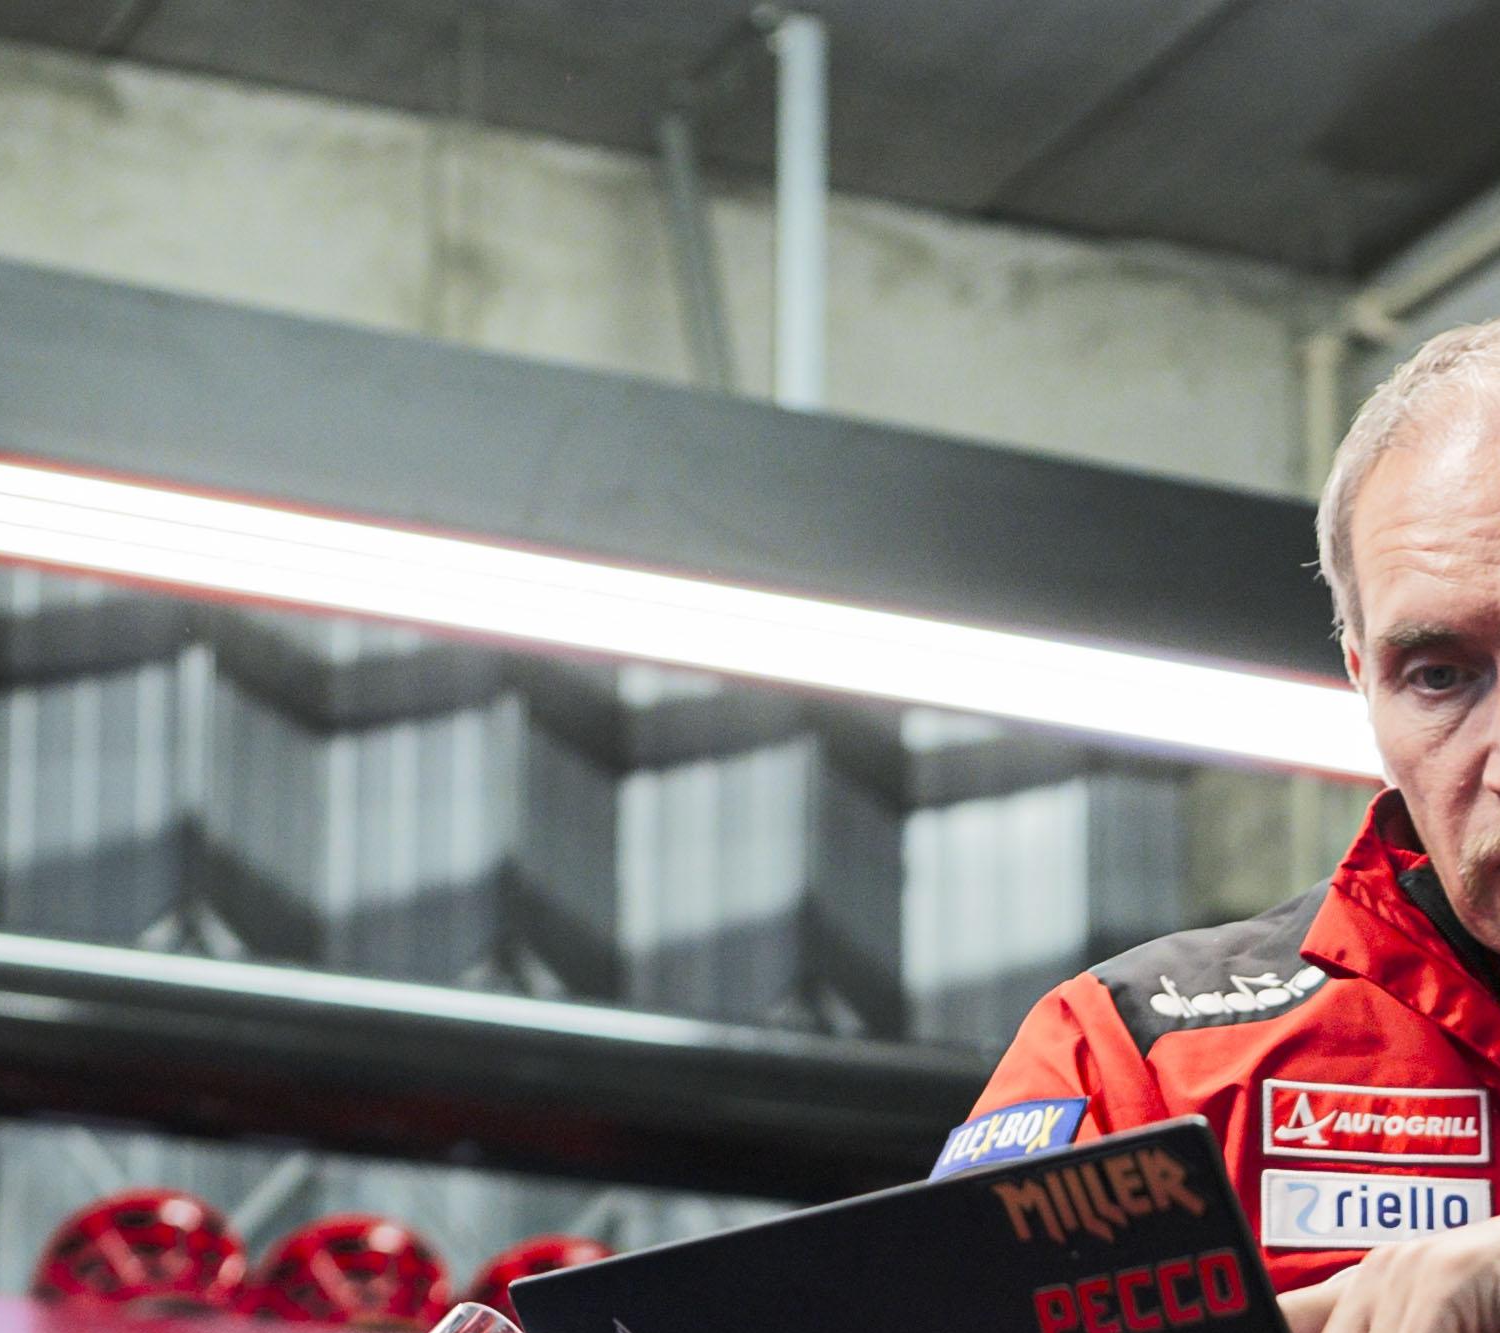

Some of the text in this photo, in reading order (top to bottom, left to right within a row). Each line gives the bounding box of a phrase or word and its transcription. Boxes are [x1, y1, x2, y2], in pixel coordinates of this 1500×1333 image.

[942, 1104, 1066, 1166] FLEX-BOX
[1334, 1109, 1479, 1139] AUTOGRILL
[991, 1147, 1206, 1245] MILLER
[1334, 1180, 1471, 1230] riello
